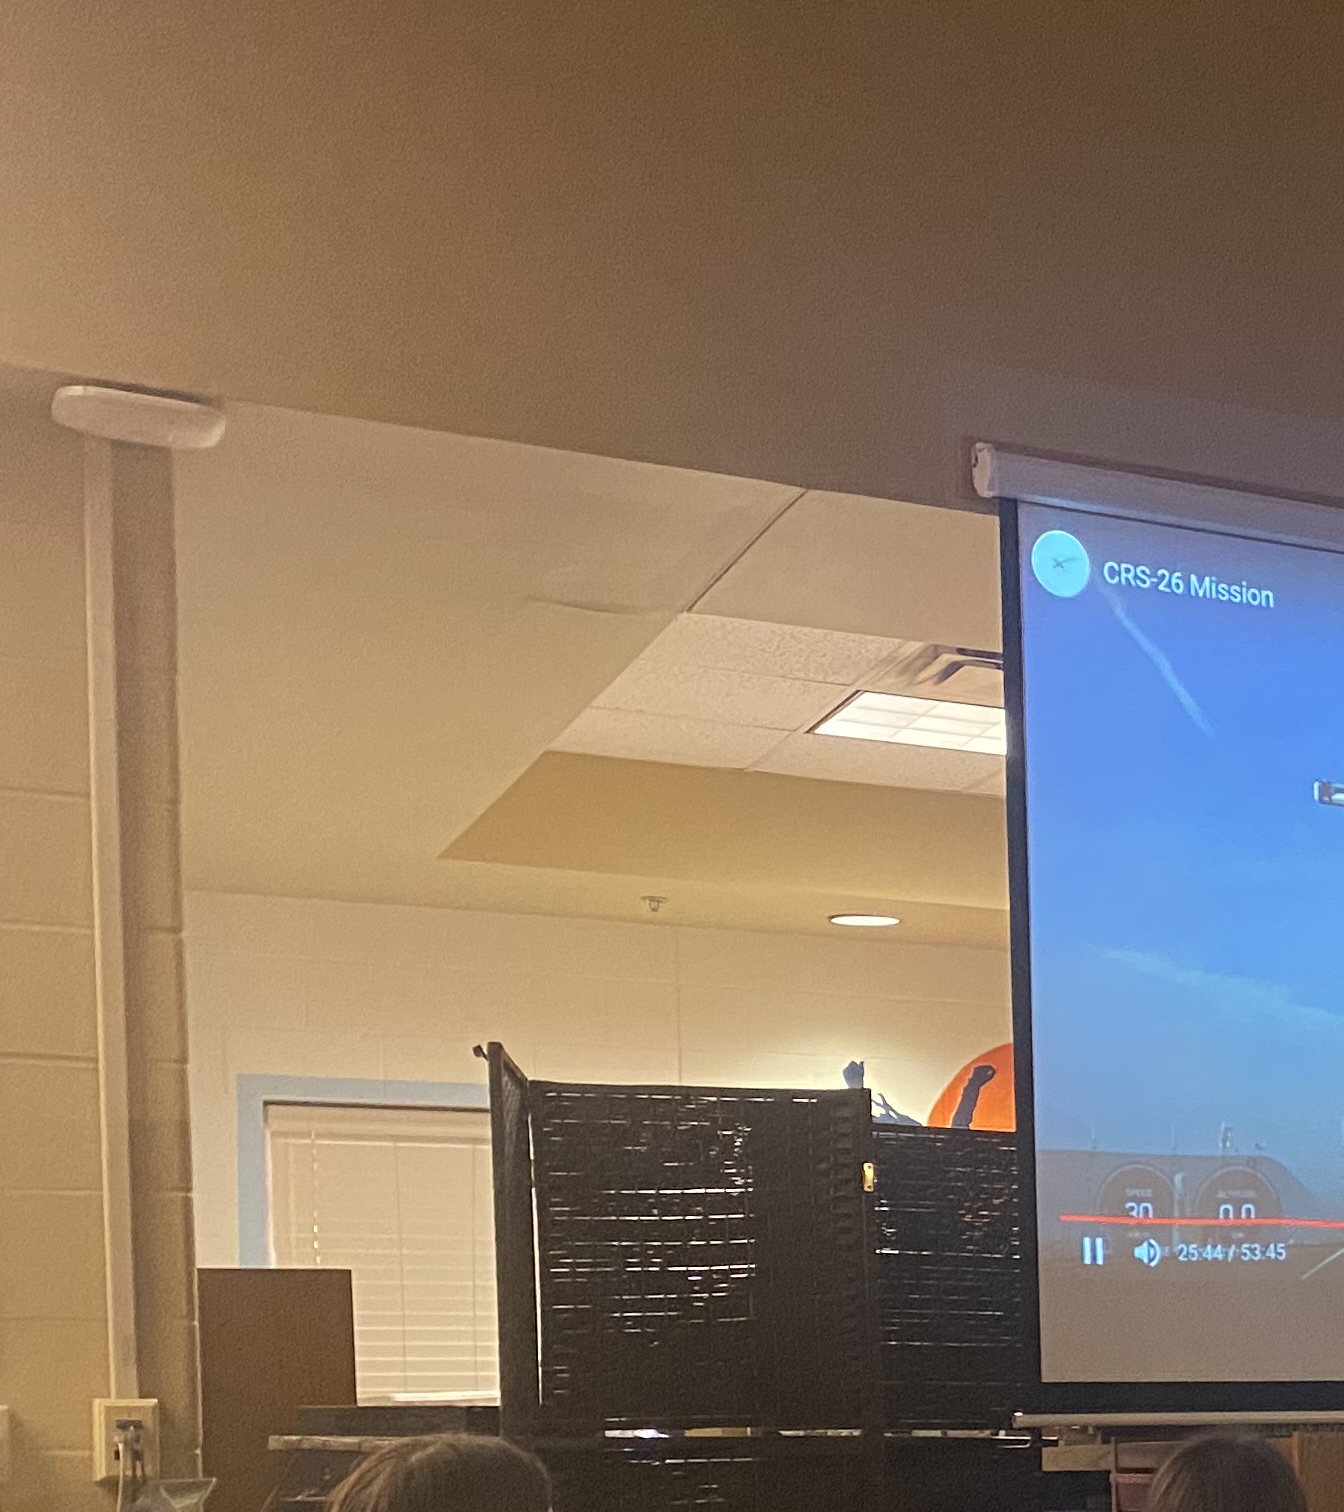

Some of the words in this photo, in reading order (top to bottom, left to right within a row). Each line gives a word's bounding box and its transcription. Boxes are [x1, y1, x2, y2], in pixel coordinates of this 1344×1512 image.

[1103, 561, 1184, 595] CRS-26
[1190, 573, 1275, 608] Mission
[1177, 1243, 1223, 1262] 25:44
[1240, 1242, 1287, 1261] 53:45
